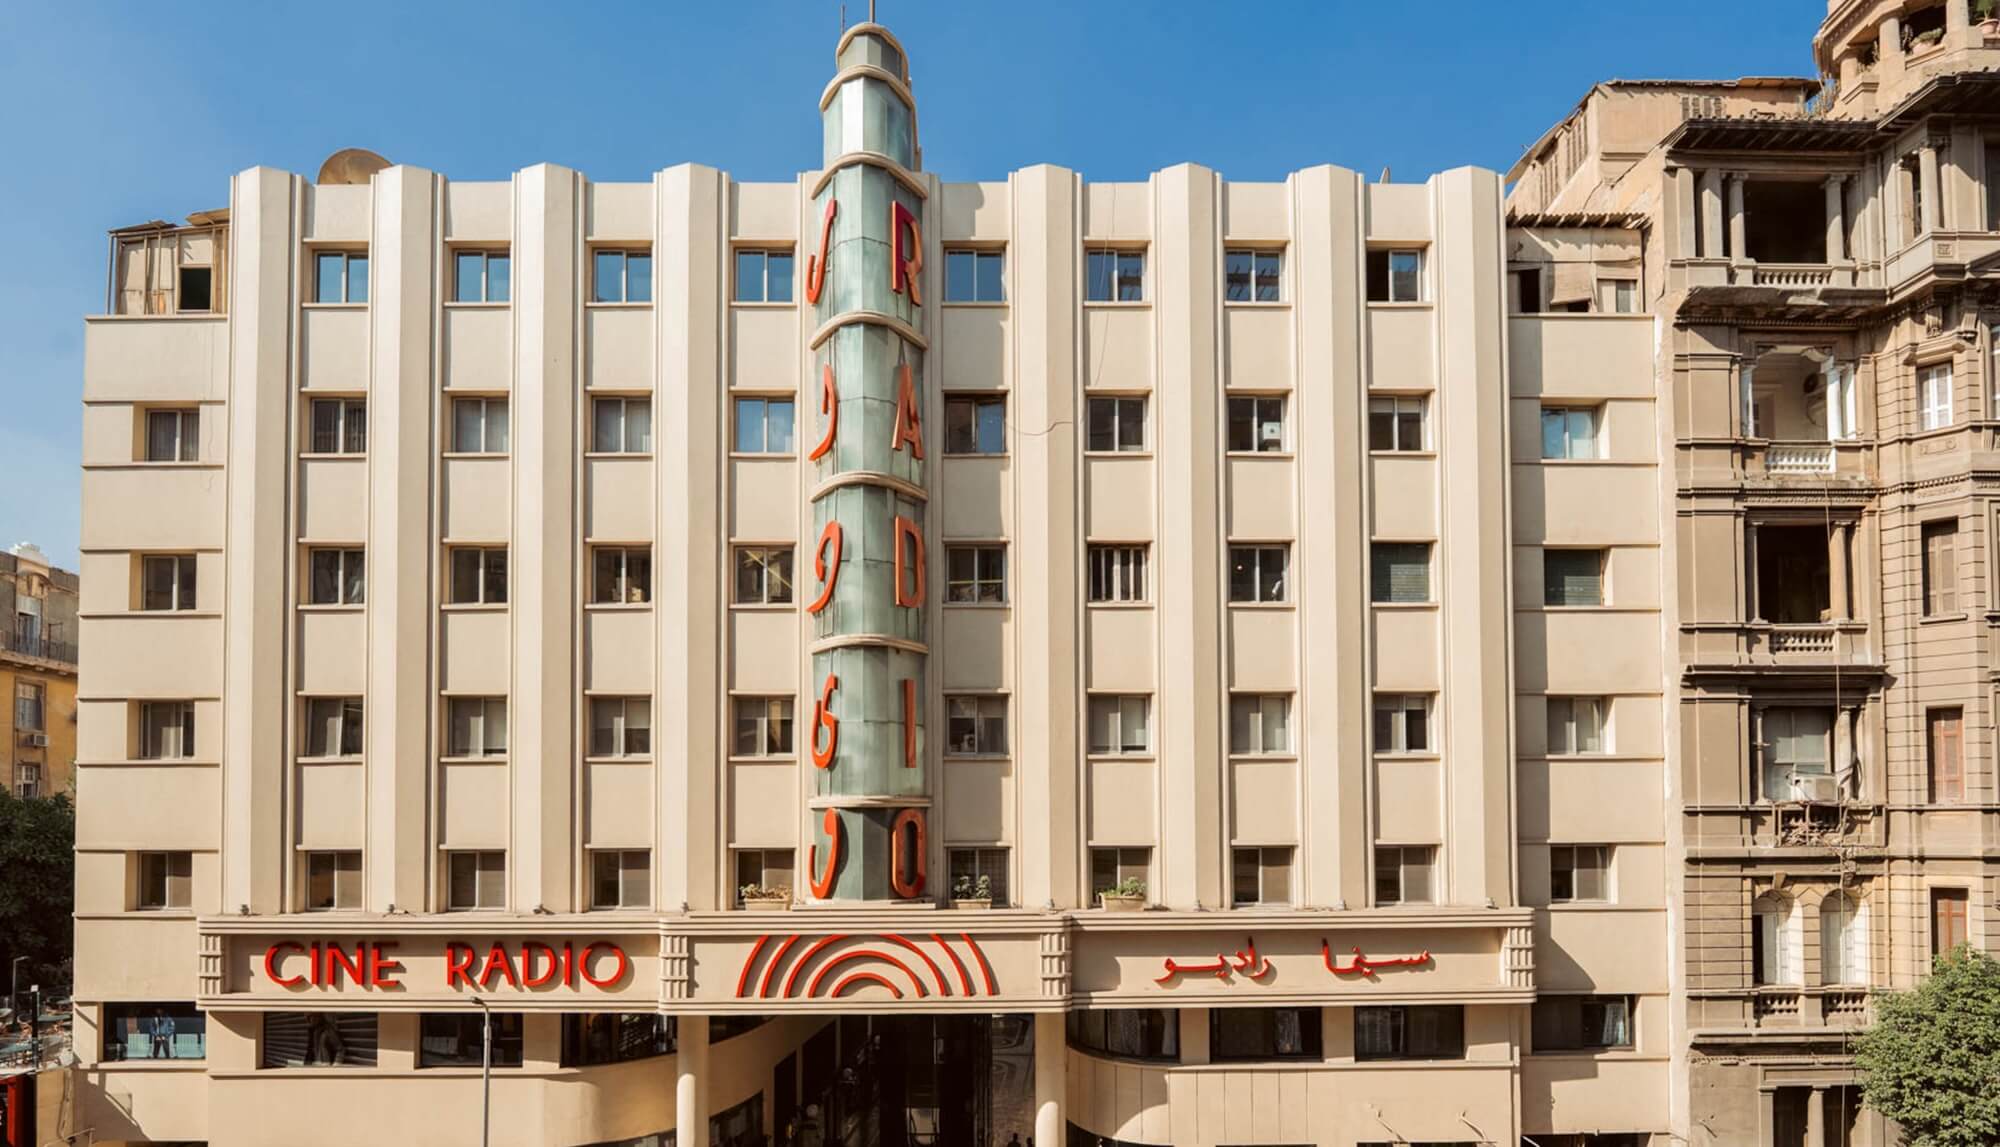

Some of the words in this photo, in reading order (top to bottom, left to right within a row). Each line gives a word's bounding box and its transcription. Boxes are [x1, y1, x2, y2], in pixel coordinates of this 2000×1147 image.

[891, 200, 927, 899] RADIO
[264, 942, 401, 989] CINE
[445, 942, 629, 990] RADIO
[1154, 936, 1270, 984] راديو
[1321, 938, 1431, 977] سينما
